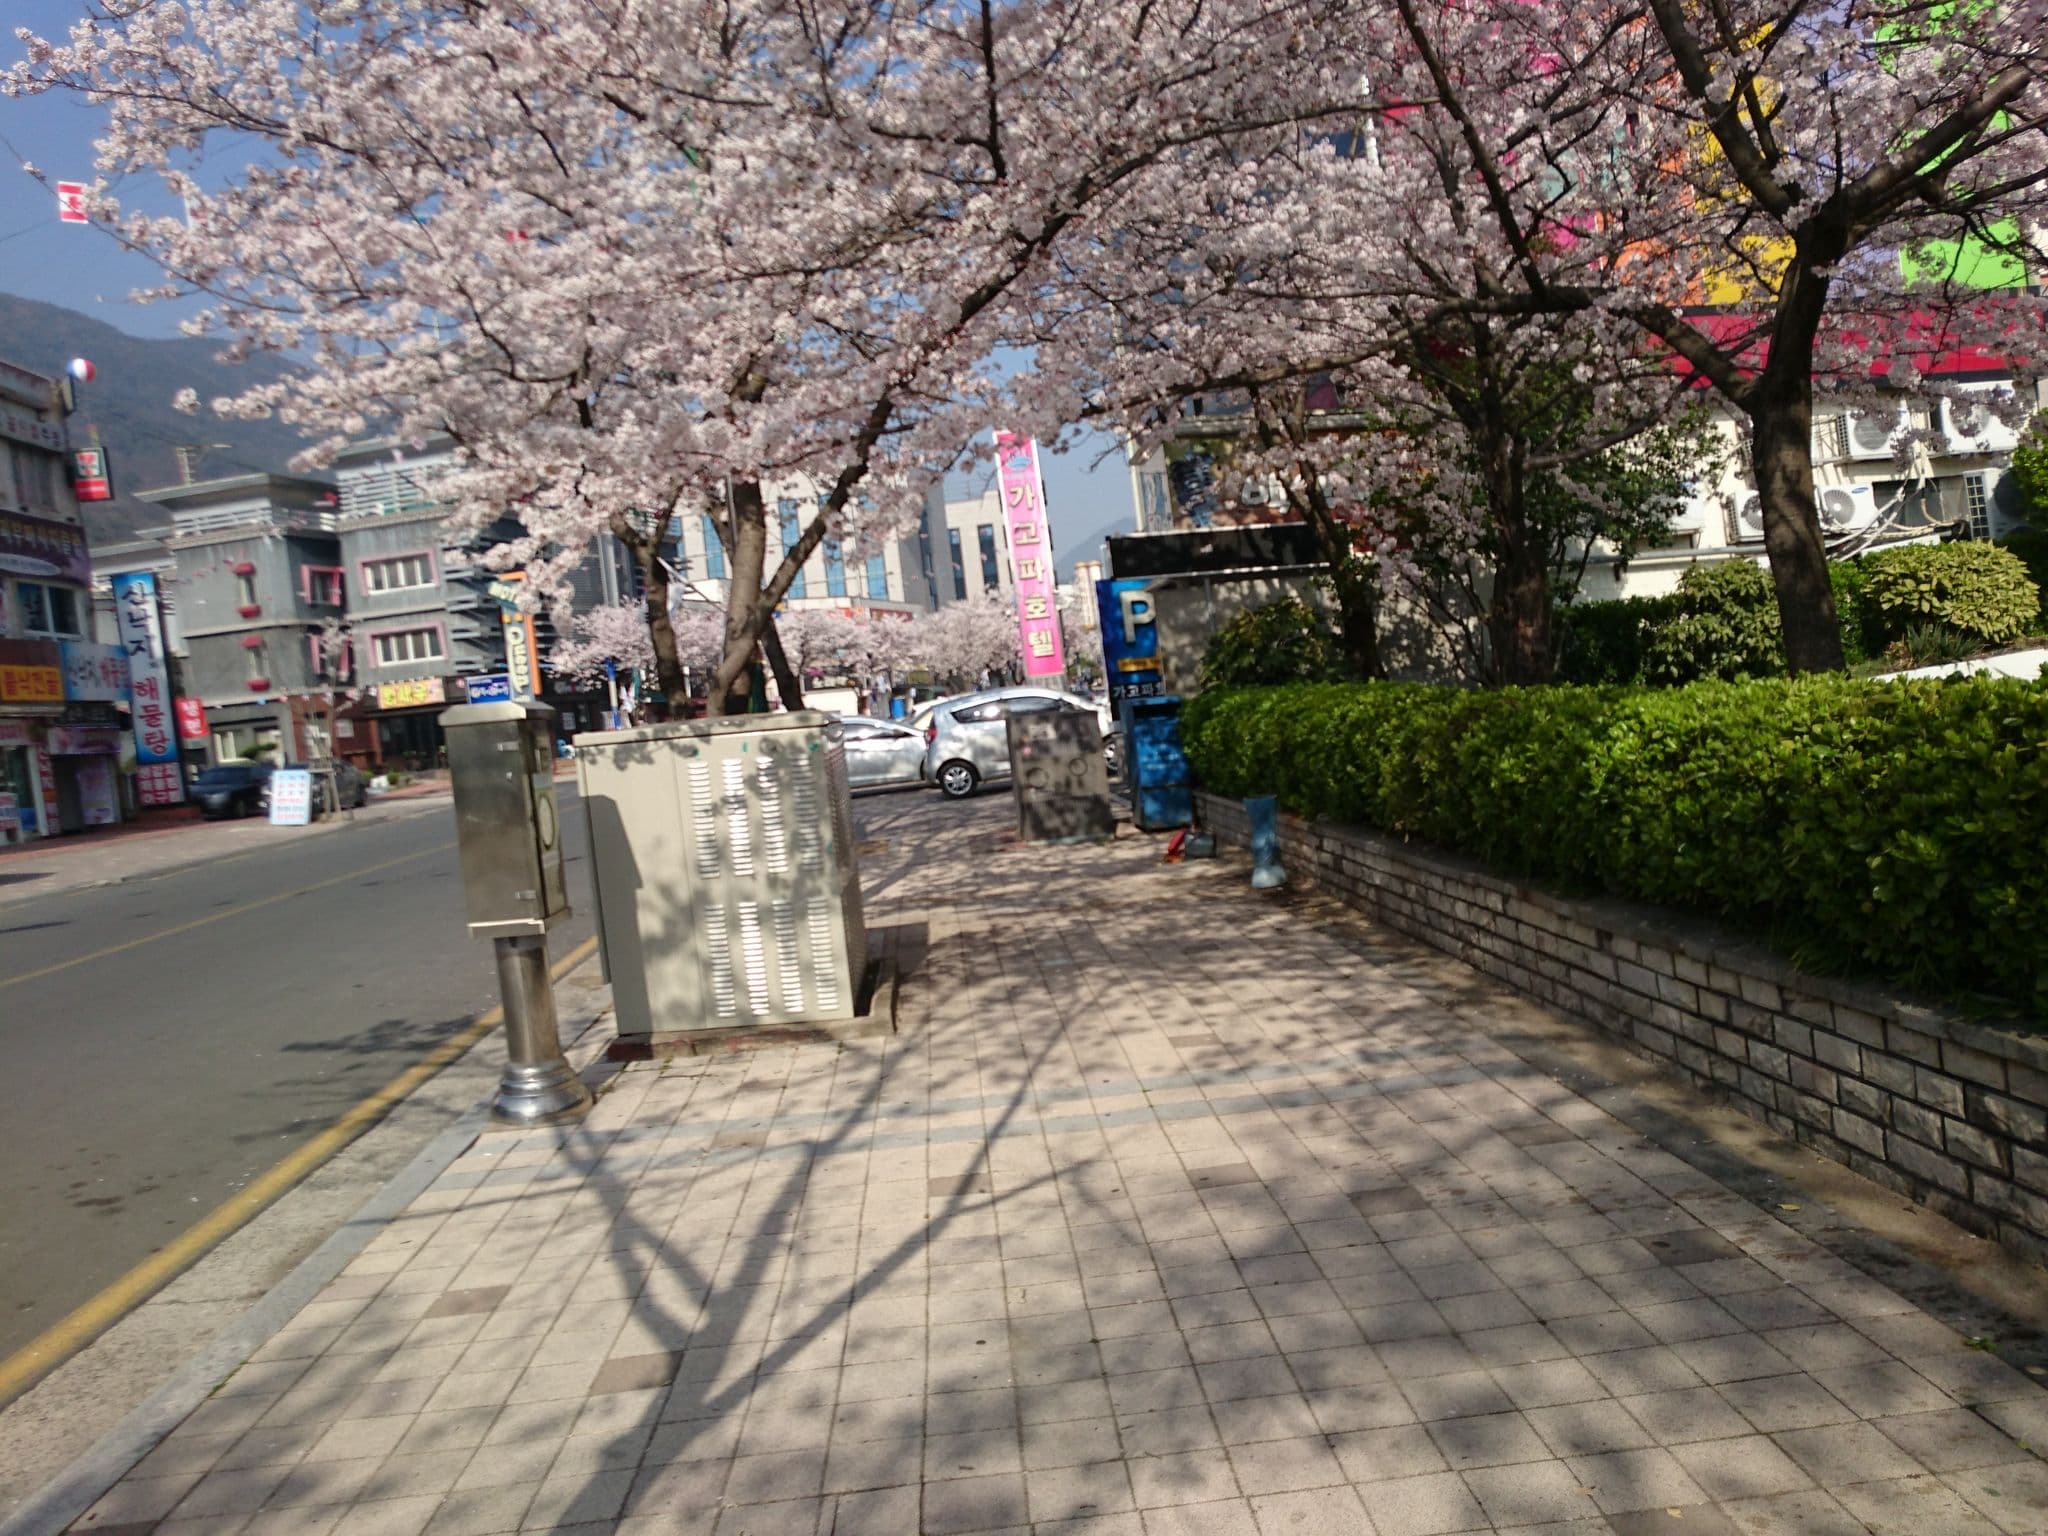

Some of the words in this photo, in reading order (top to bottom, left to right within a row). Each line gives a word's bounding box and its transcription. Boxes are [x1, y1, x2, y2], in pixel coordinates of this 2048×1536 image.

[1009, 481, 1056, 658] 가고파호텔
[1120, 590, 1157, 643] P
[133, 676, 170, 755] 해물탕
